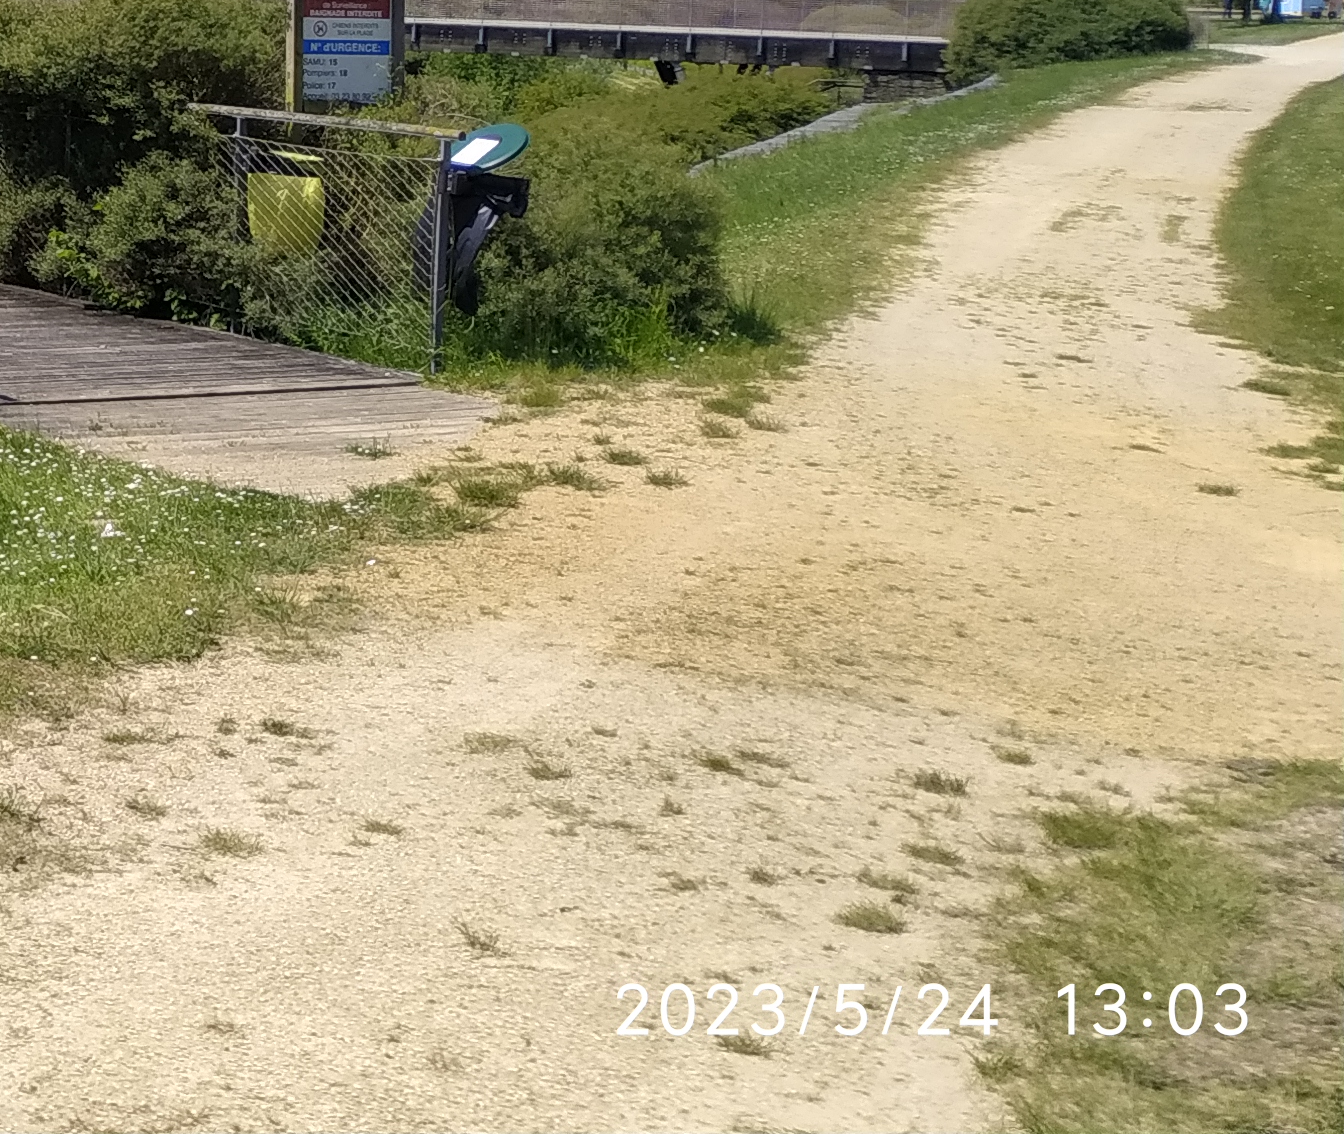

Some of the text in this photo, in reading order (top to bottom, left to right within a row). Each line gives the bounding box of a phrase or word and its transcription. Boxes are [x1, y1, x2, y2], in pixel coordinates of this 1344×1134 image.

[310, 9, 382, 18] BAIGNADE INTERDITE
[329, 58, 338, 66] 15
[339, 69, 348, 77] 18
[327, 81, 336, 89] 17
